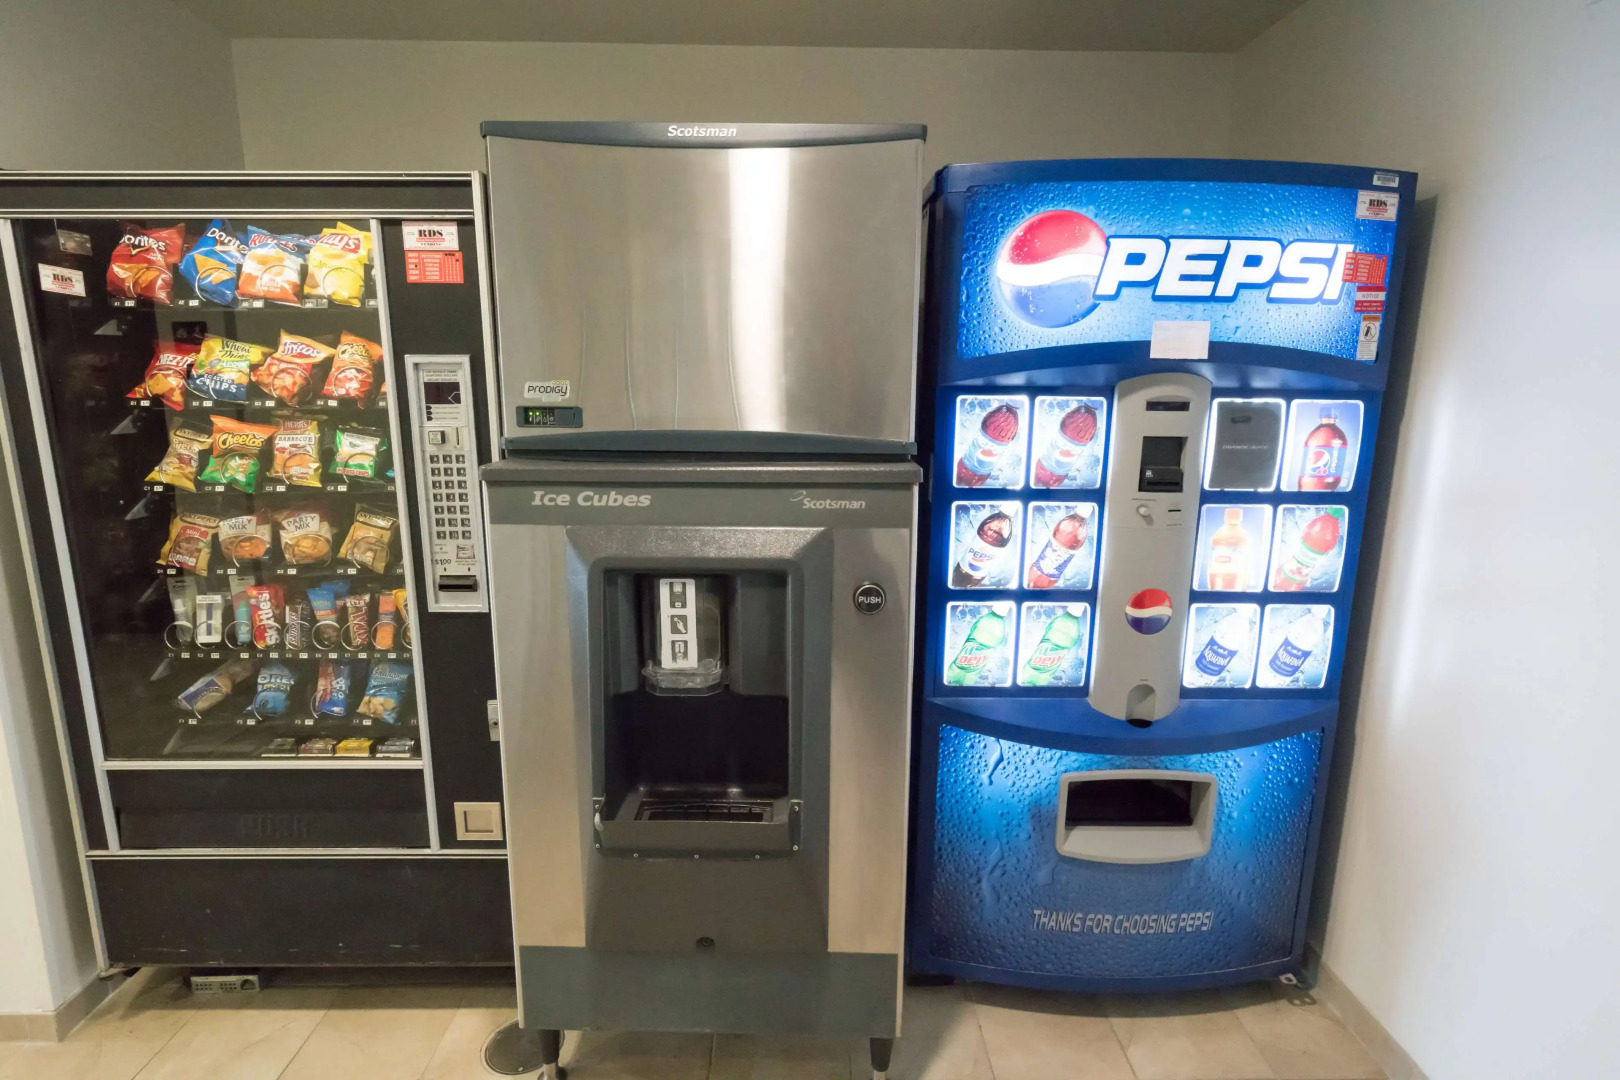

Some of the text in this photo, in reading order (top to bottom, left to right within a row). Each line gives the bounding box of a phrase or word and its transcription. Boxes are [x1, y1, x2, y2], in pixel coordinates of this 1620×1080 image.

[667, 125, 737, 137] Scotsman
[1368, 199, 1388, 207] RDS
[418, 229, 443, 237] RDS
[1095, 238, 1356, 300] PEPSI
[52, 273, 73, 283] RDS
[196, 377, 238, 393] CHIPS
[219, 432, 265, 450] Cheetos
[531, 491, 651, 507] Ice Cubes
[802, 498, 866, 509] Scotsman
[285, 515, 317, 528] PARTY
[294, 522, 311, 532] MIX
[185, 528, 200, 537] Mini
[228, 523, 248, 532] MIX
[858, 595, 882, 604] PUSH
[1032, 910, 1214, 935] THANKS FOR CHOOSING PEPSI
